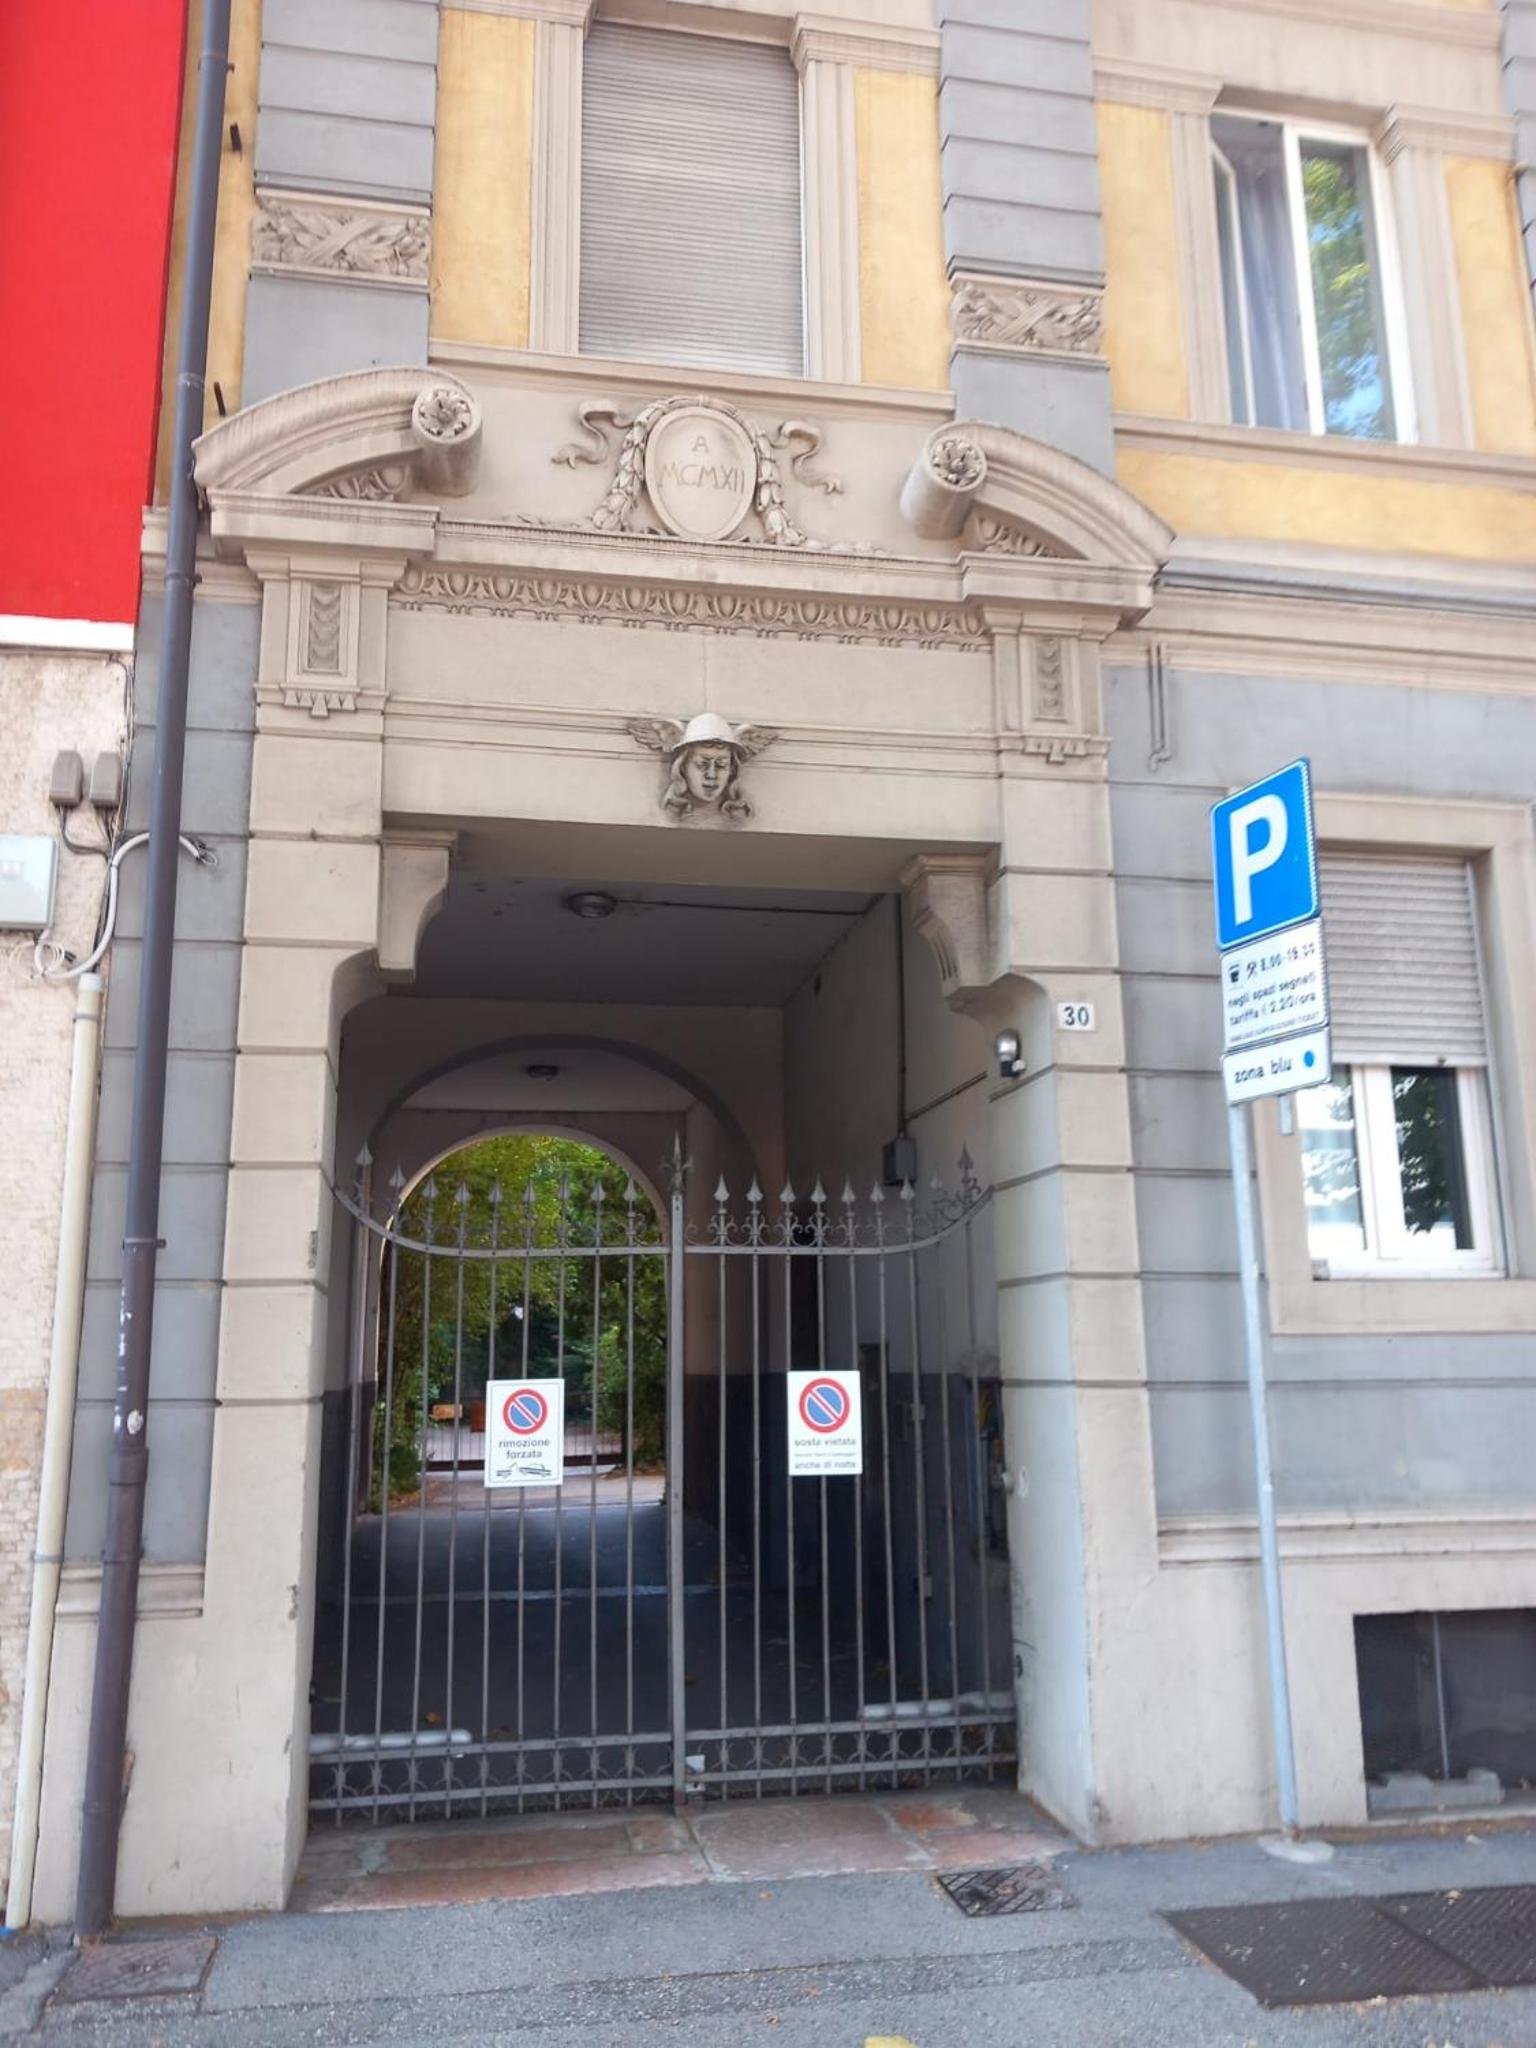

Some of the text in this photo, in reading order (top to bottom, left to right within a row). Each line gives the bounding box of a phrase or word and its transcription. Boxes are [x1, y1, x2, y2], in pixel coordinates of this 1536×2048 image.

[692, 435, 709, 453] A
[1230, 794, 1288, 927] P
[1064, 1006, 1089, 1026] 30
[1235, 1056, 1292, 1084] zona blu
[498, 1438, 550, 1448] rimozione
[794, 1437, 857, 1446] sosta vietata
[506, 1449, 543, 1459] forzata
